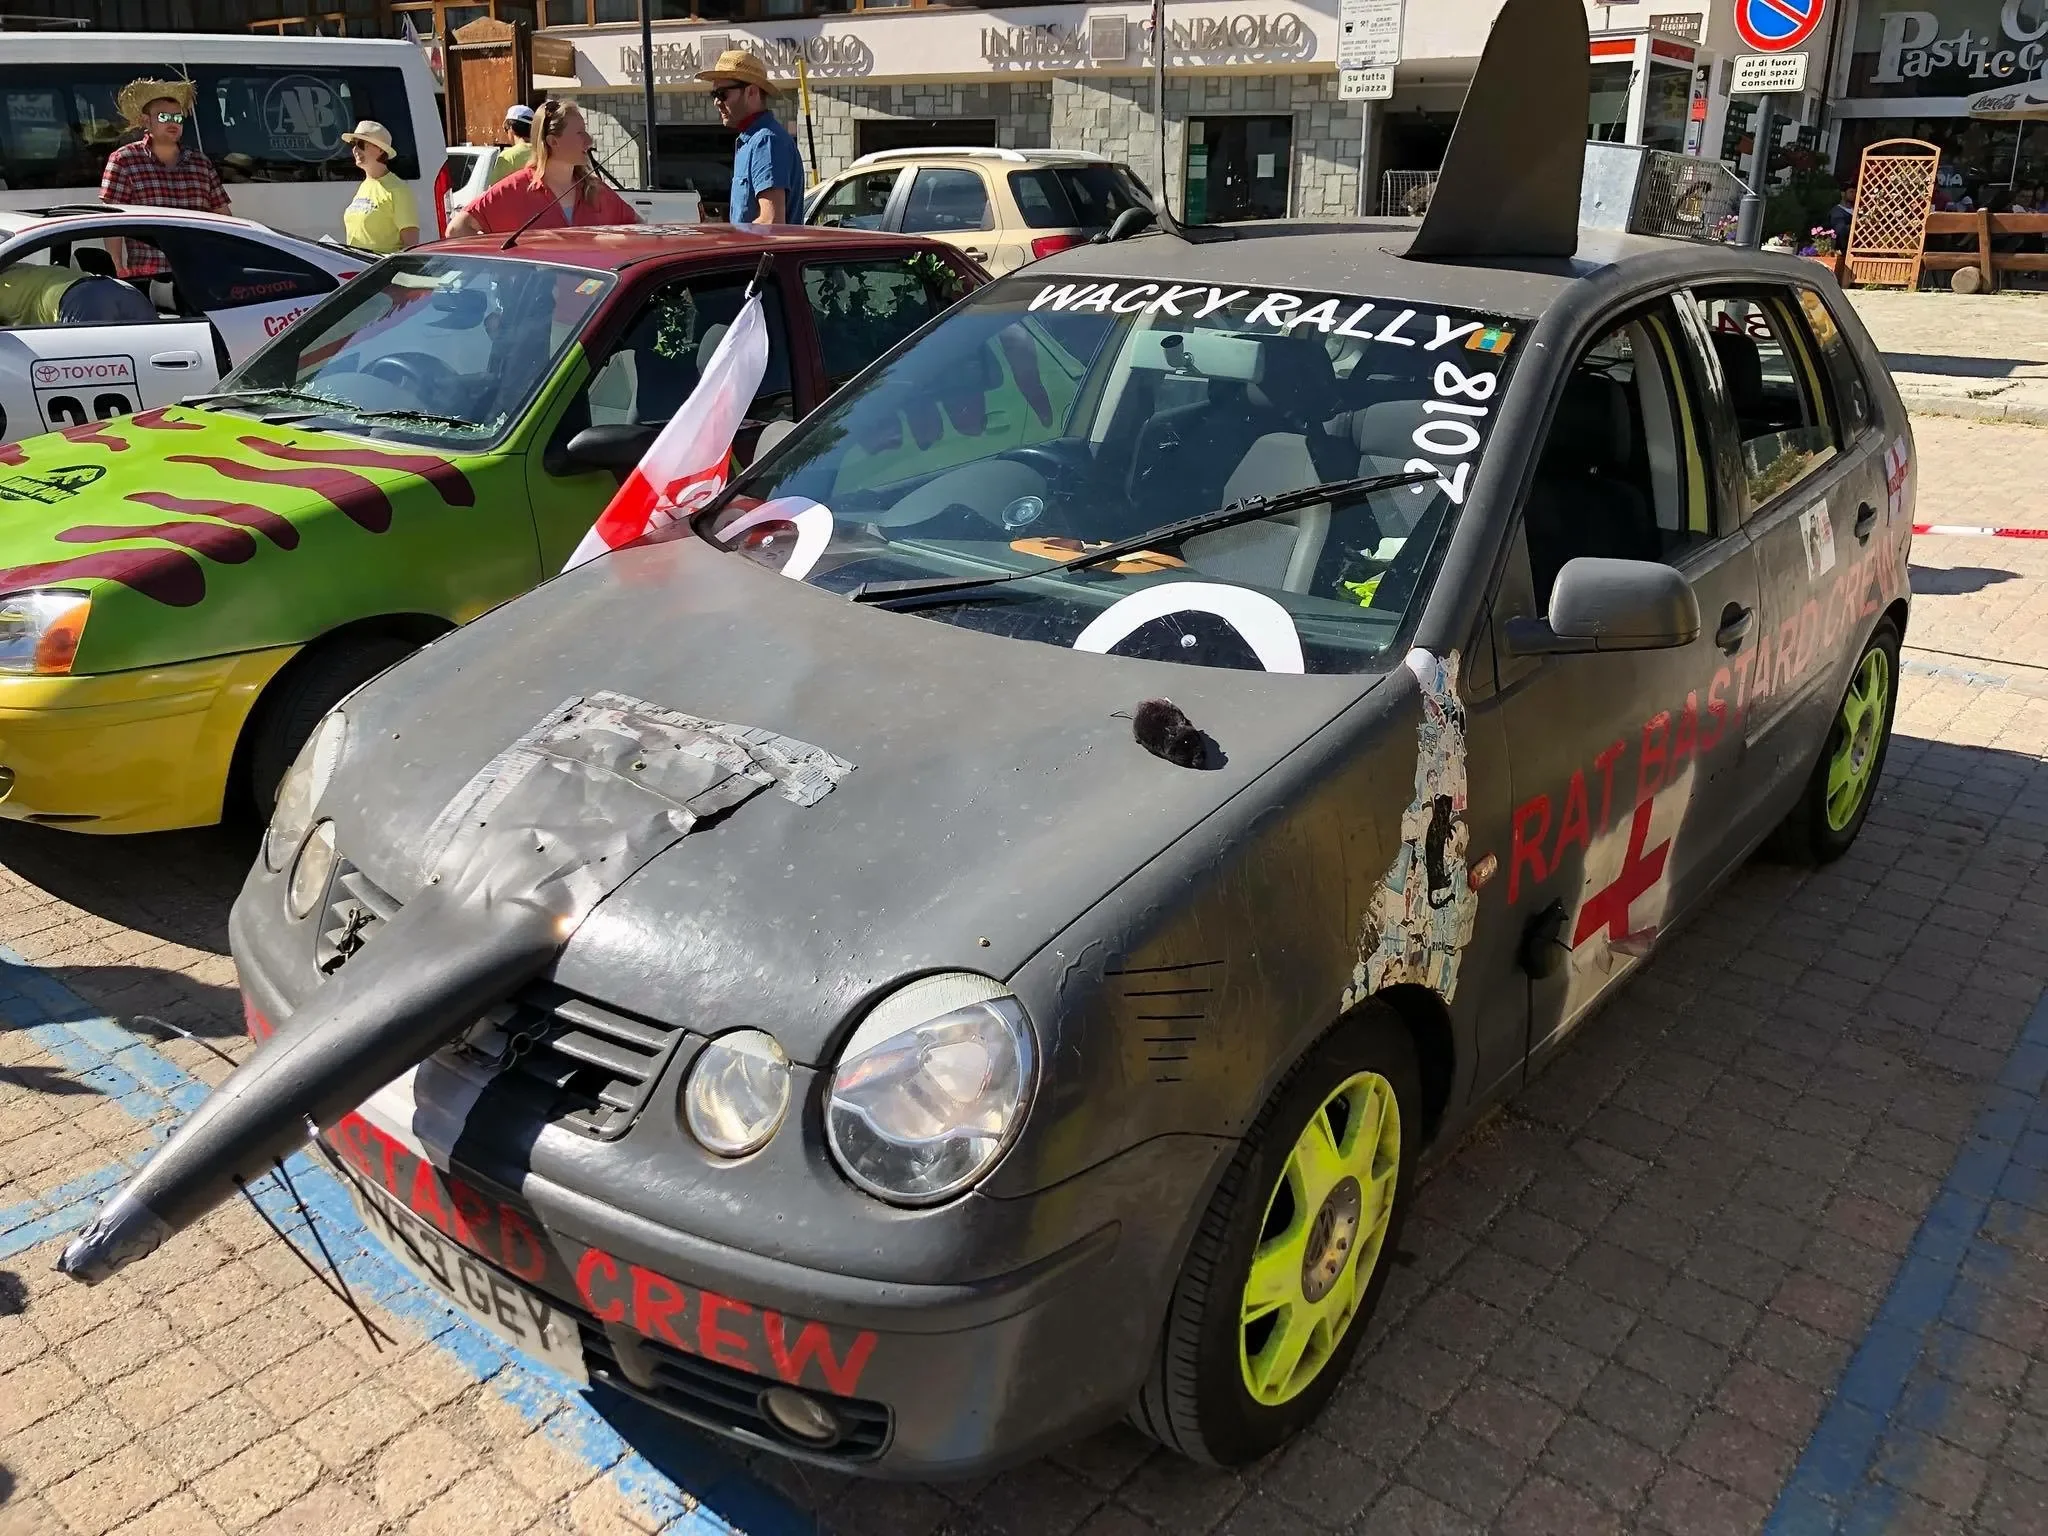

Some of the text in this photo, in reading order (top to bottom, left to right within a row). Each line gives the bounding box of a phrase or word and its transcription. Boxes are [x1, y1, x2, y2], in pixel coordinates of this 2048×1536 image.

[1660, 22, 1698, 31] REGGIMENTO
[1662, 16, 1688, 24] PIAZZA
[981, 23, 1084, 58] INTESA
[1869, 11, 2048, 83] Pasticc
[1745, 57, 1797, 67] al di fuori
[1361, 72, 1386, 81] tutta
[1741, 67, 1798, 79] degli spazi
[1741, 77, 1795, 87] consentiti
[1344, 83, 1387, 94] la piazza
[249, 279, 298, 297] TOYOTA
[263, 306, 310, 338] Cast
[1027, 282, 1484, 352] WACKY RALLY
[61, 364, 129, 379] TOYOTA
[1404, 360, 1498, 506] 2018
[1508, 532, 1901, 905] RAT BASTARD CREW
[326, 1110, 877, 1399] STARD CREW
[458, 1256, 552, 1352] GEY
